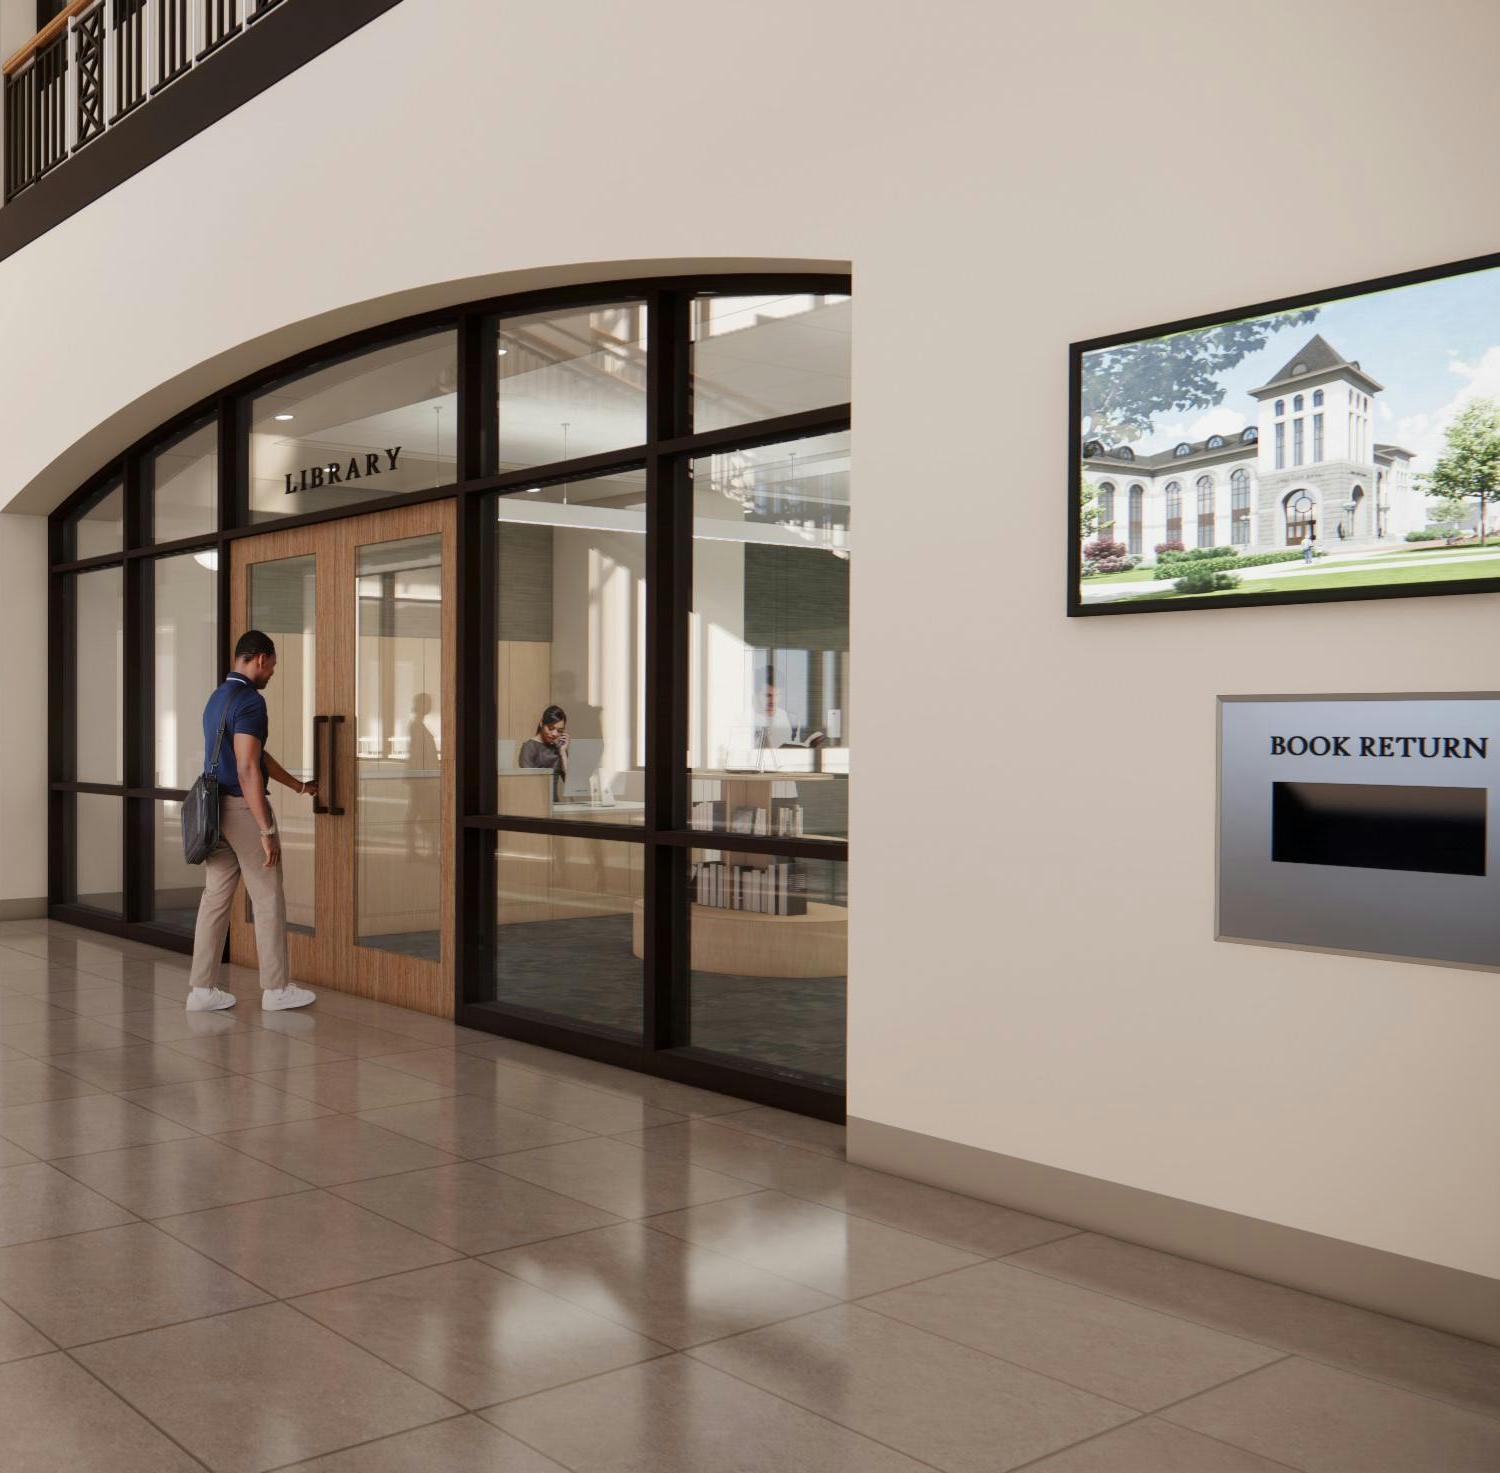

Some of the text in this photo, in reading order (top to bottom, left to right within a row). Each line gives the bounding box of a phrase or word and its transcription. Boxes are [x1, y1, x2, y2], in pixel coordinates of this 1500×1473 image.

[284, 446, 402, 494] LIBRARY
[1270, 735, 1489, 760] BOOK RETURN
